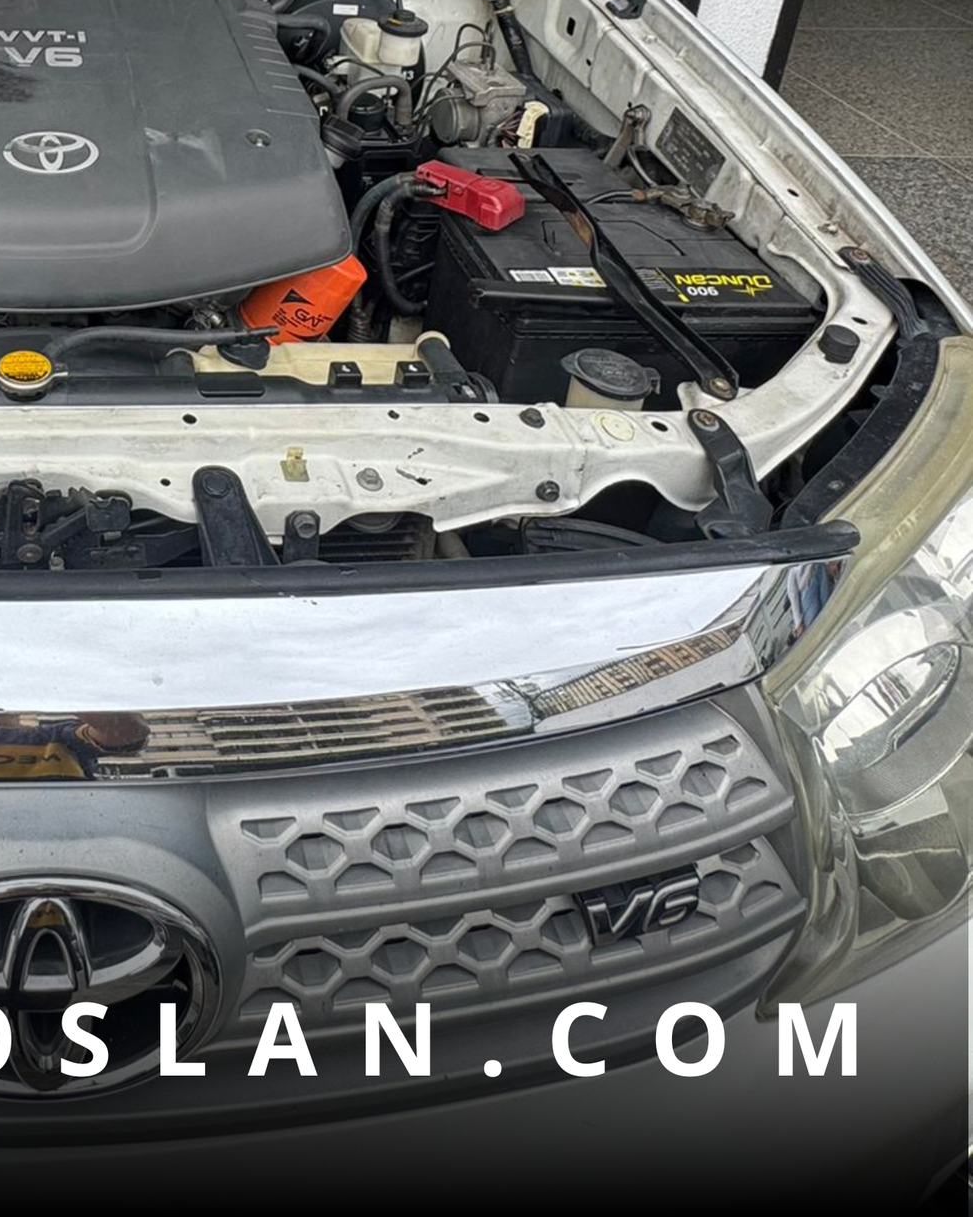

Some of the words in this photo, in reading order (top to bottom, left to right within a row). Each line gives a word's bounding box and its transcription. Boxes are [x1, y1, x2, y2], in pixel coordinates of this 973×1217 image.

[4, 47, 83, 67] V6
[687, 286, 719, 296] 900
[584, 875, 700, 947] V6
